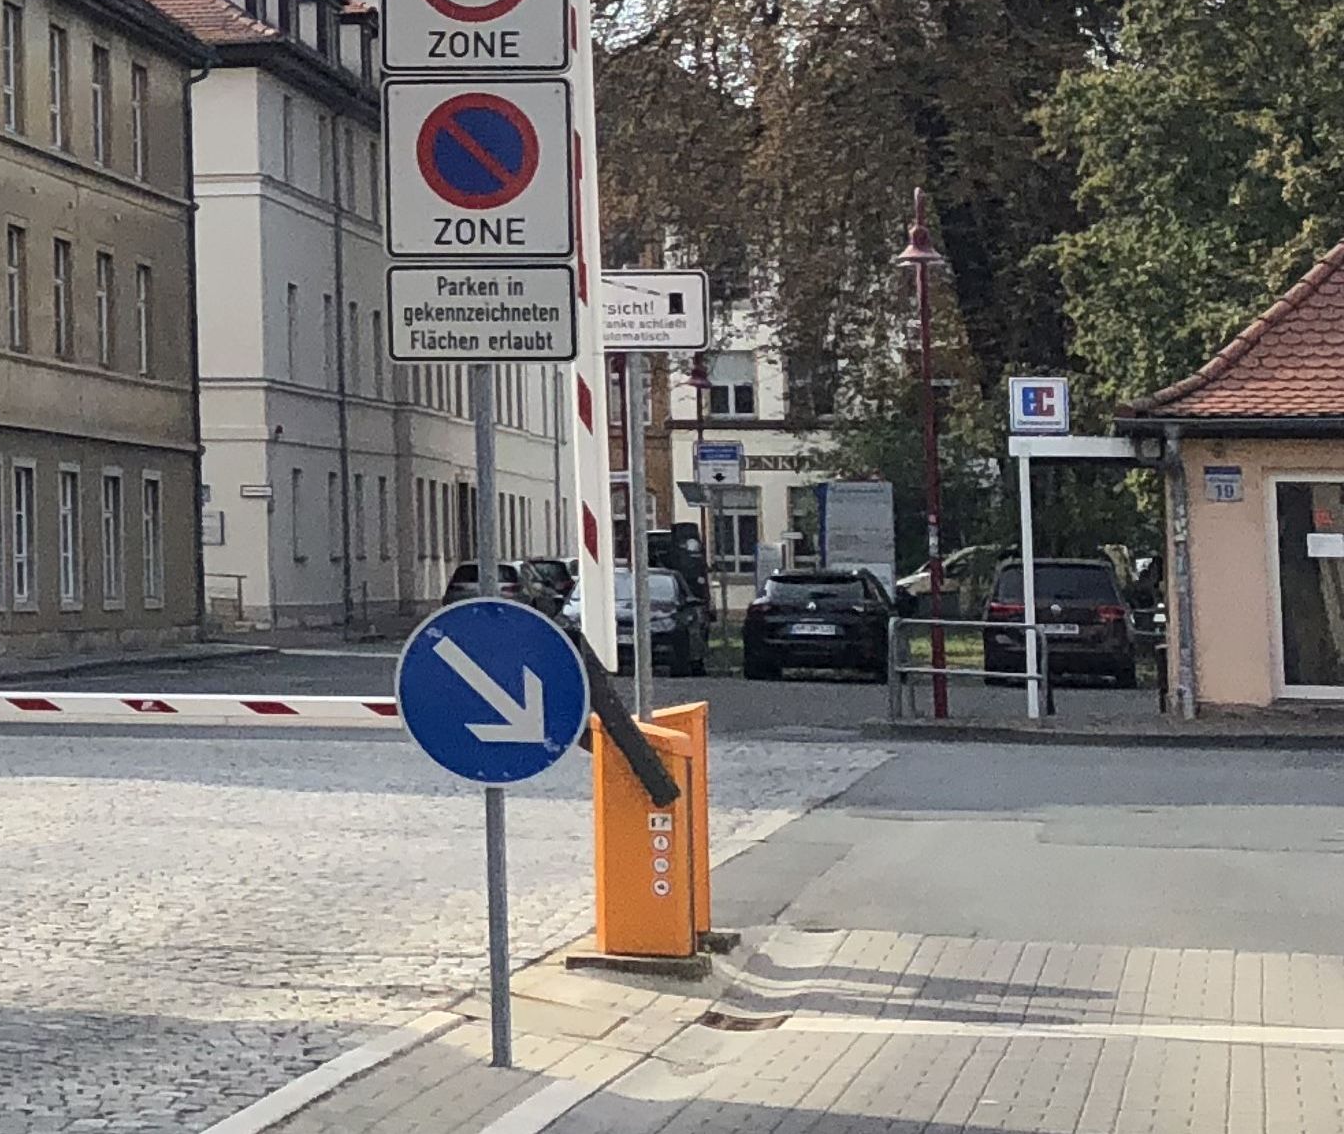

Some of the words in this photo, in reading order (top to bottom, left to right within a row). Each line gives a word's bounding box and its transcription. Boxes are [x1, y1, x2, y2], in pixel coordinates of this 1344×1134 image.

[428, 31, 520, 58] ZONE
[433, 218, 526, 245] ZONE
[437, 276, 500, 296] Parken
[507, 276, 524, 296] in
[403, 302, 560, 327] gekennzeichneten
[411, 330, 480, 351] Flächen
[488, 330, 553, 351] erlaubt
